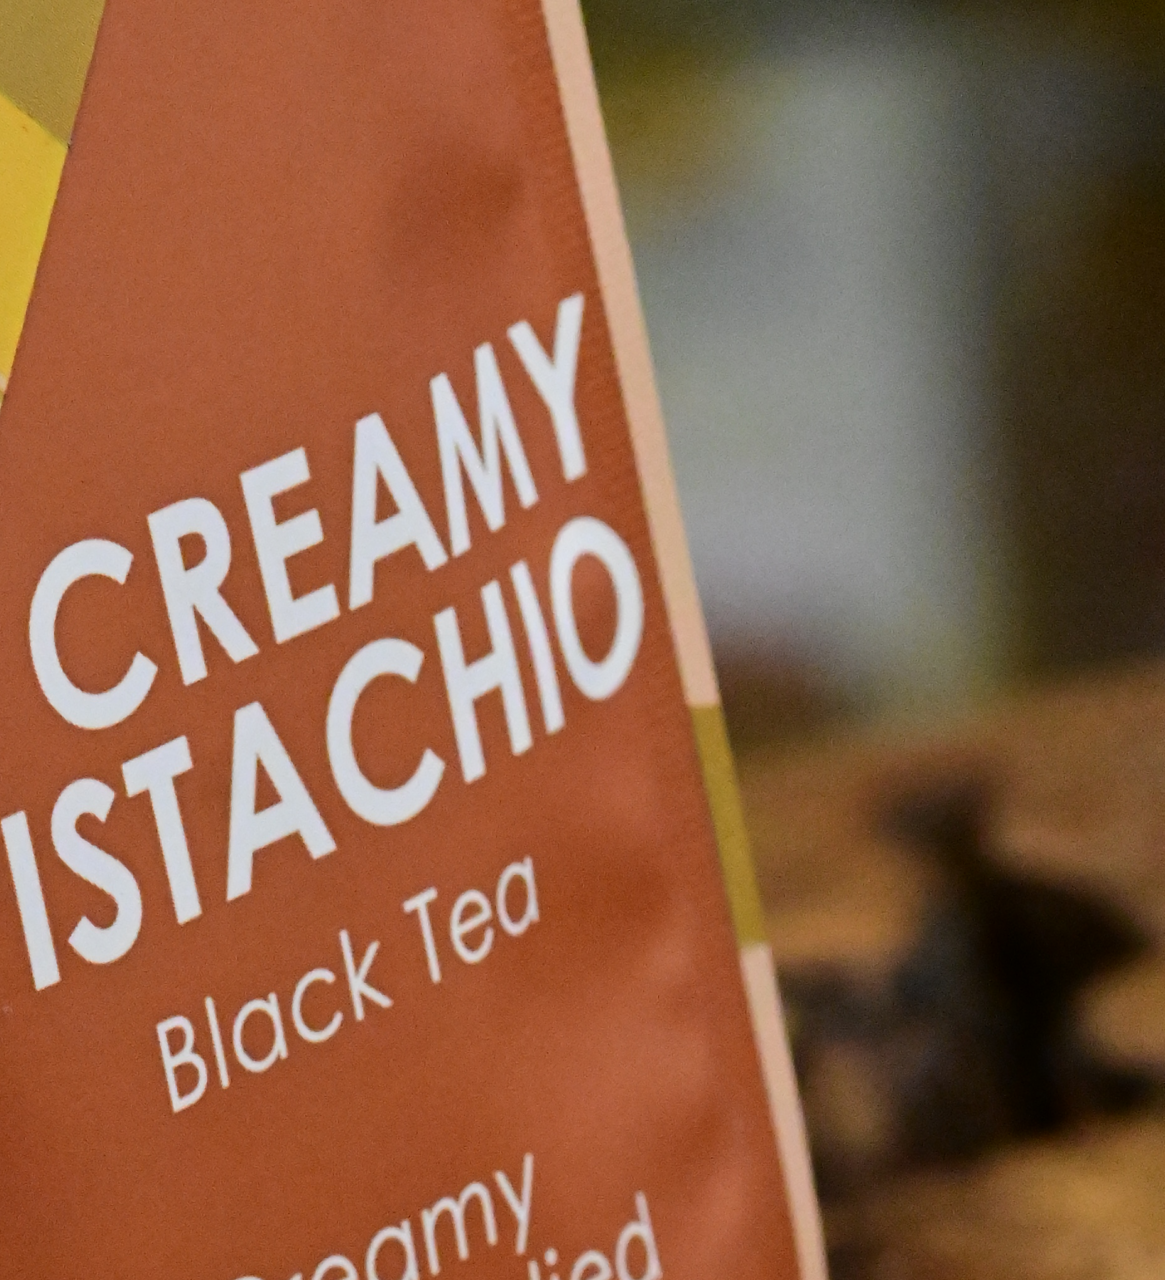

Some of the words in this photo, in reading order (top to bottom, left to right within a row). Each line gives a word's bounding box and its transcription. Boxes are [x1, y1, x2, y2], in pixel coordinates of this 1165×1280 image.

[29, 292, 587, 731] CREAMY
[156, 930, 394, 1113] Black
[403, 856, 540, 985] Tea
